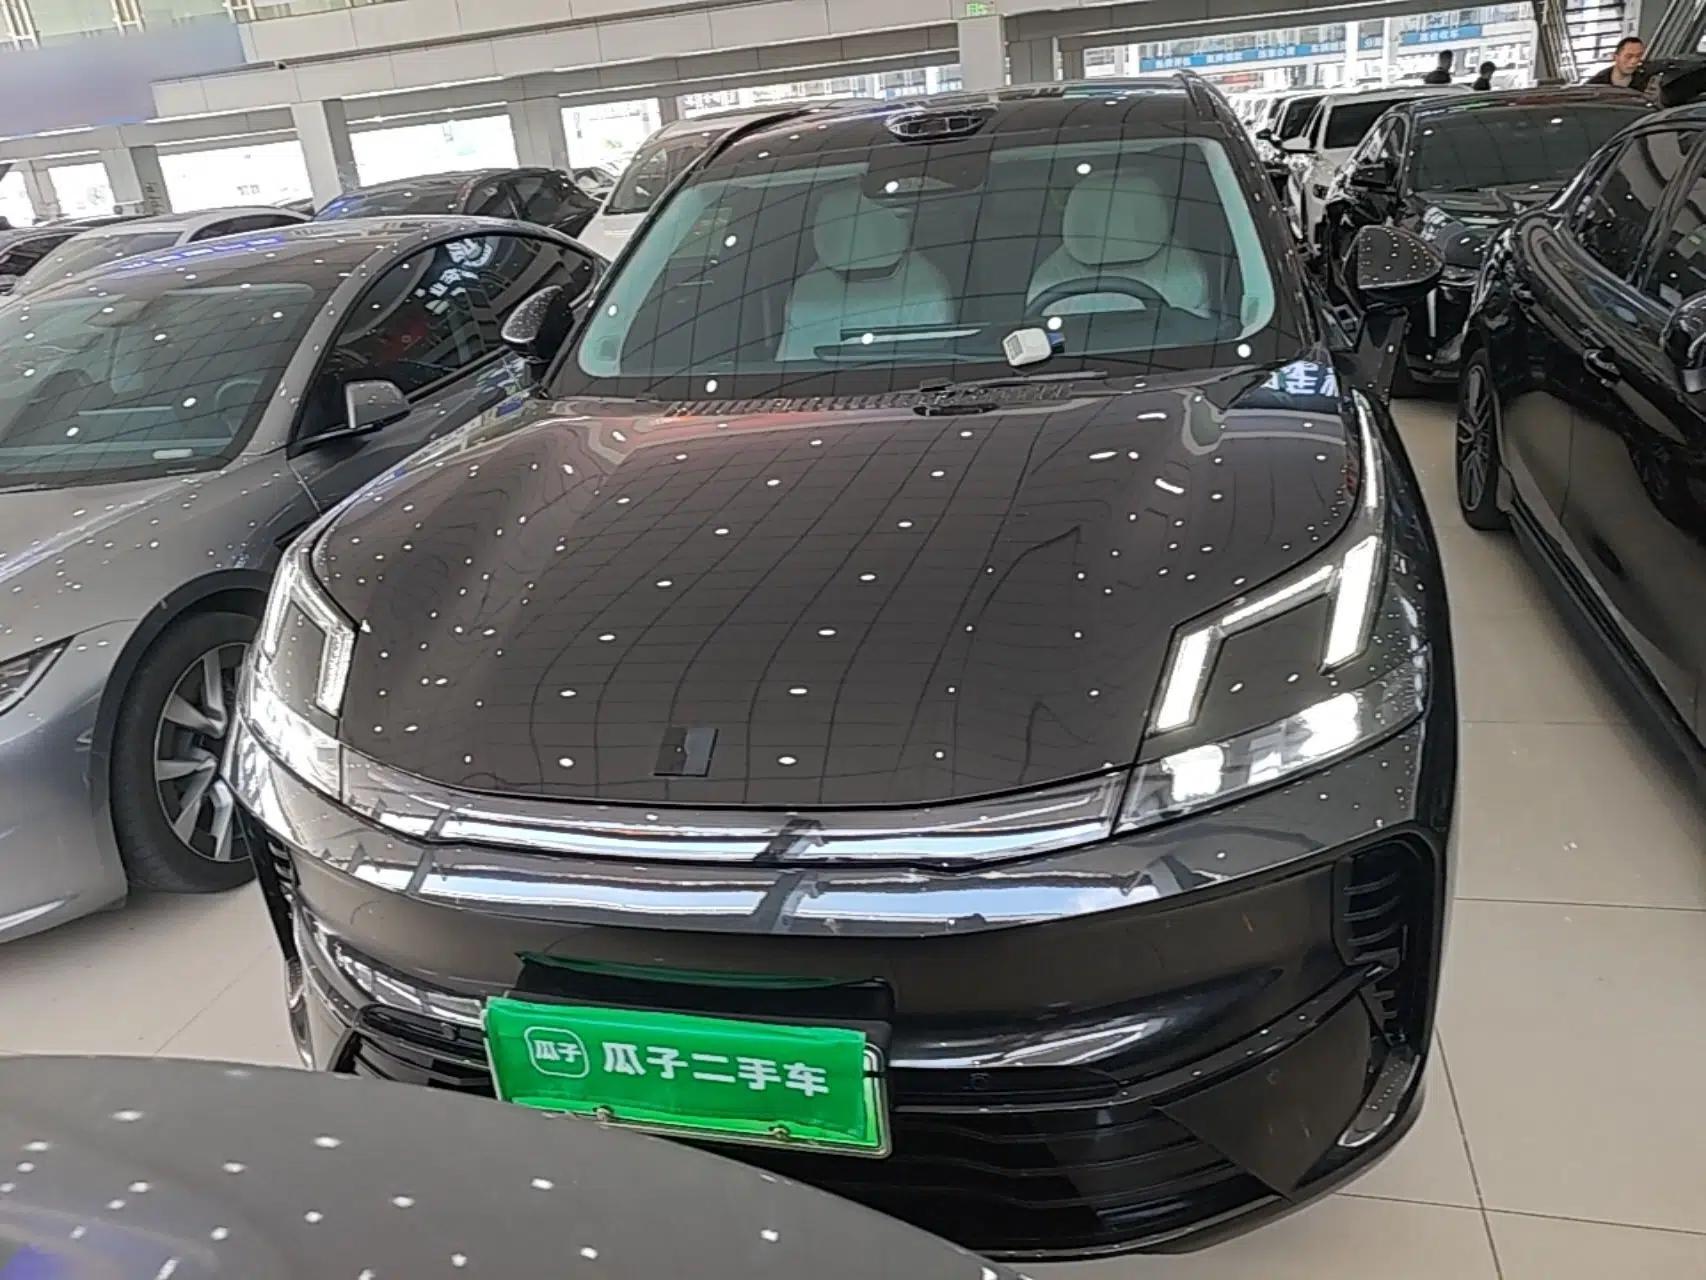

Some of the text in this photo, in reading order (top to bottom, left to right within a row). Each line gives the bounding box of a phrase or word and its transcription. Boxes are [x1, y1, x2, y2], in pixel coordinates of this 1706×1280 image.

[534, 1038, 583, 1064] 瓜子
[602, 1041, 829, 1097] 瓜子二手车
